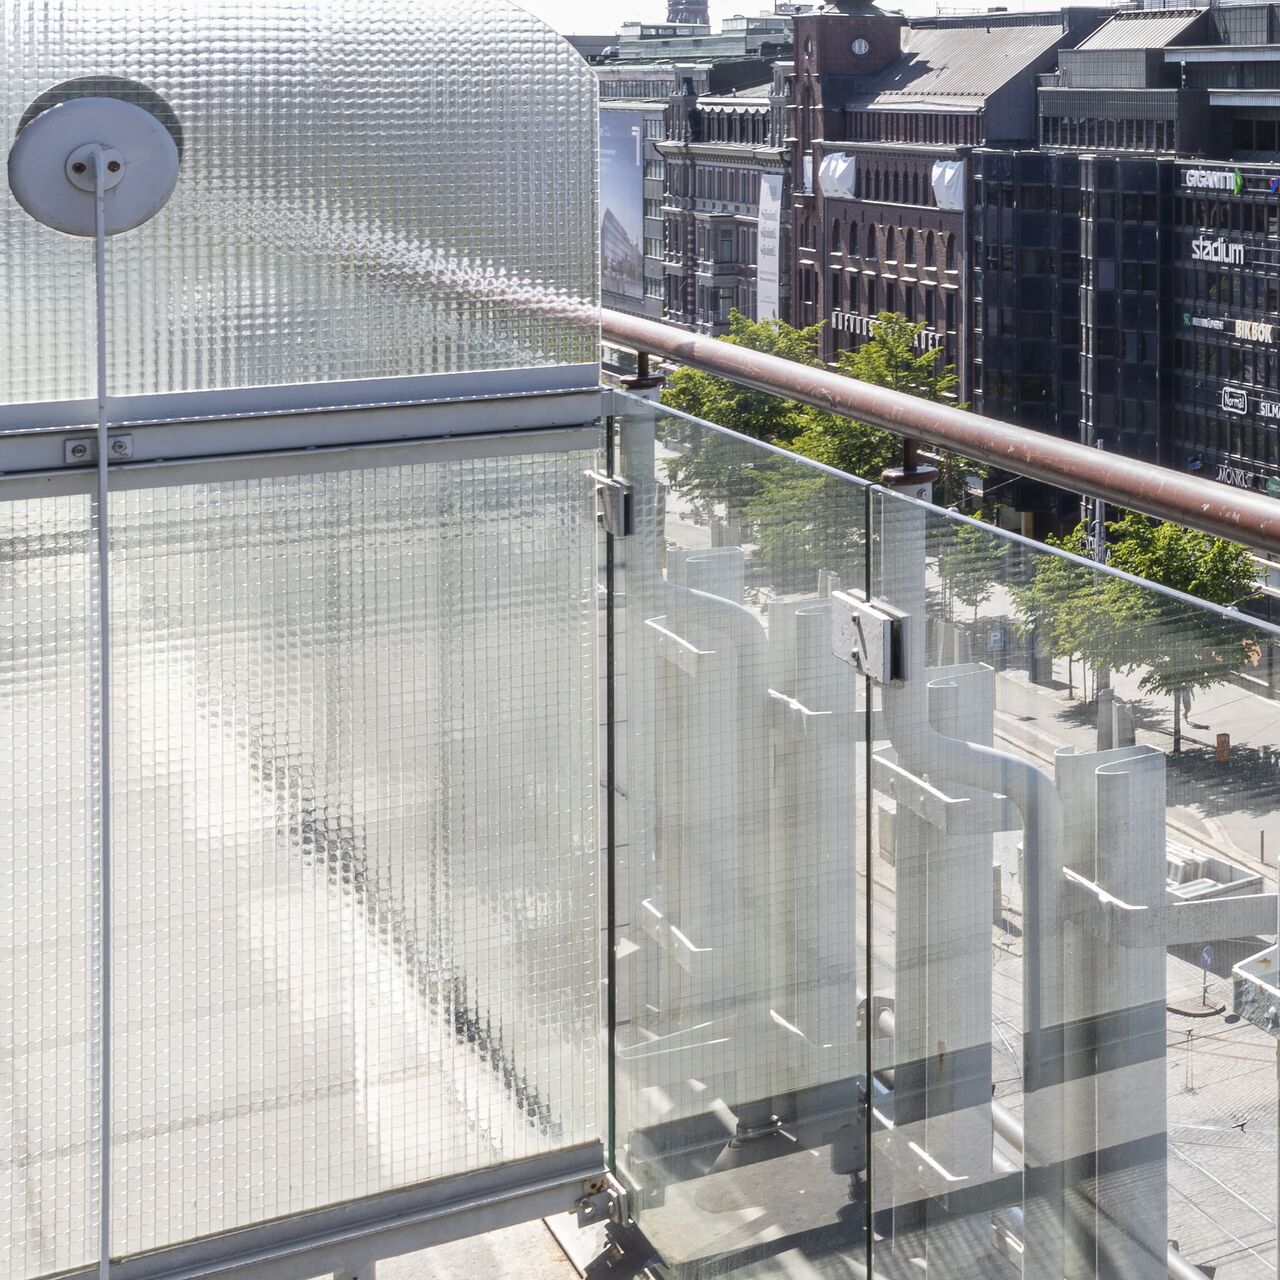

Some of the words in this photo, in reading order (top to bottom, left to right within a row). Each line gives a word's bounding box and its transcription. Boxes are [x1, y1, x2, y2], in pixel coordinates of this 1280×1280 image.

[1186, 170, 1236, 190] GIGANTTI
[1191, 235, 1246, 265] stadium
[1224, 393, 1245, 409] Normal
[990, 632, 1001, 646] P
